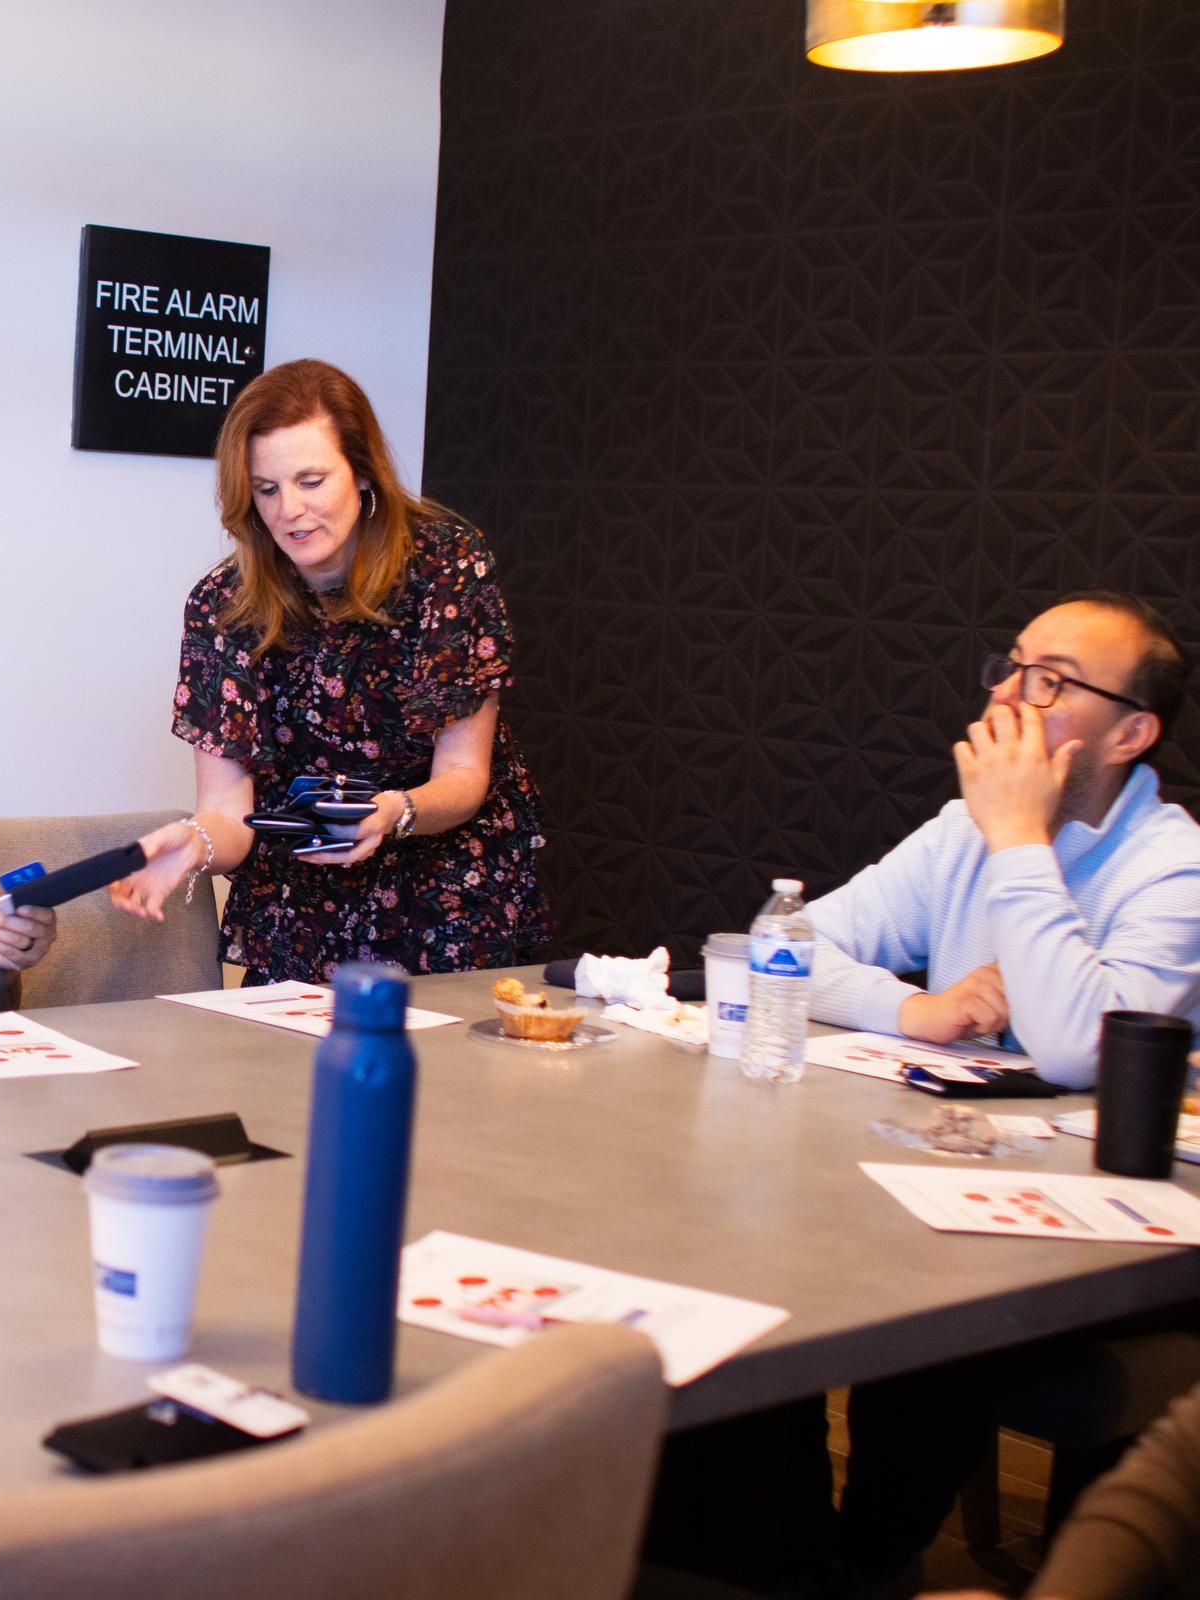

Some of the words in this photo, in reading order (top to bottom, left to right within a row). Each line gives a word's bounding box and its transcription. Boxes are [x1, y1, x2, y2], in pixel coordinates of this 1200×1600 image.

[96, 280, 160, 314] FIRE
[165, 288, 259, 325] ALARM
[107, 325, 246, 365] TERMINAL
[115, 369, 235, 405] CABINET
